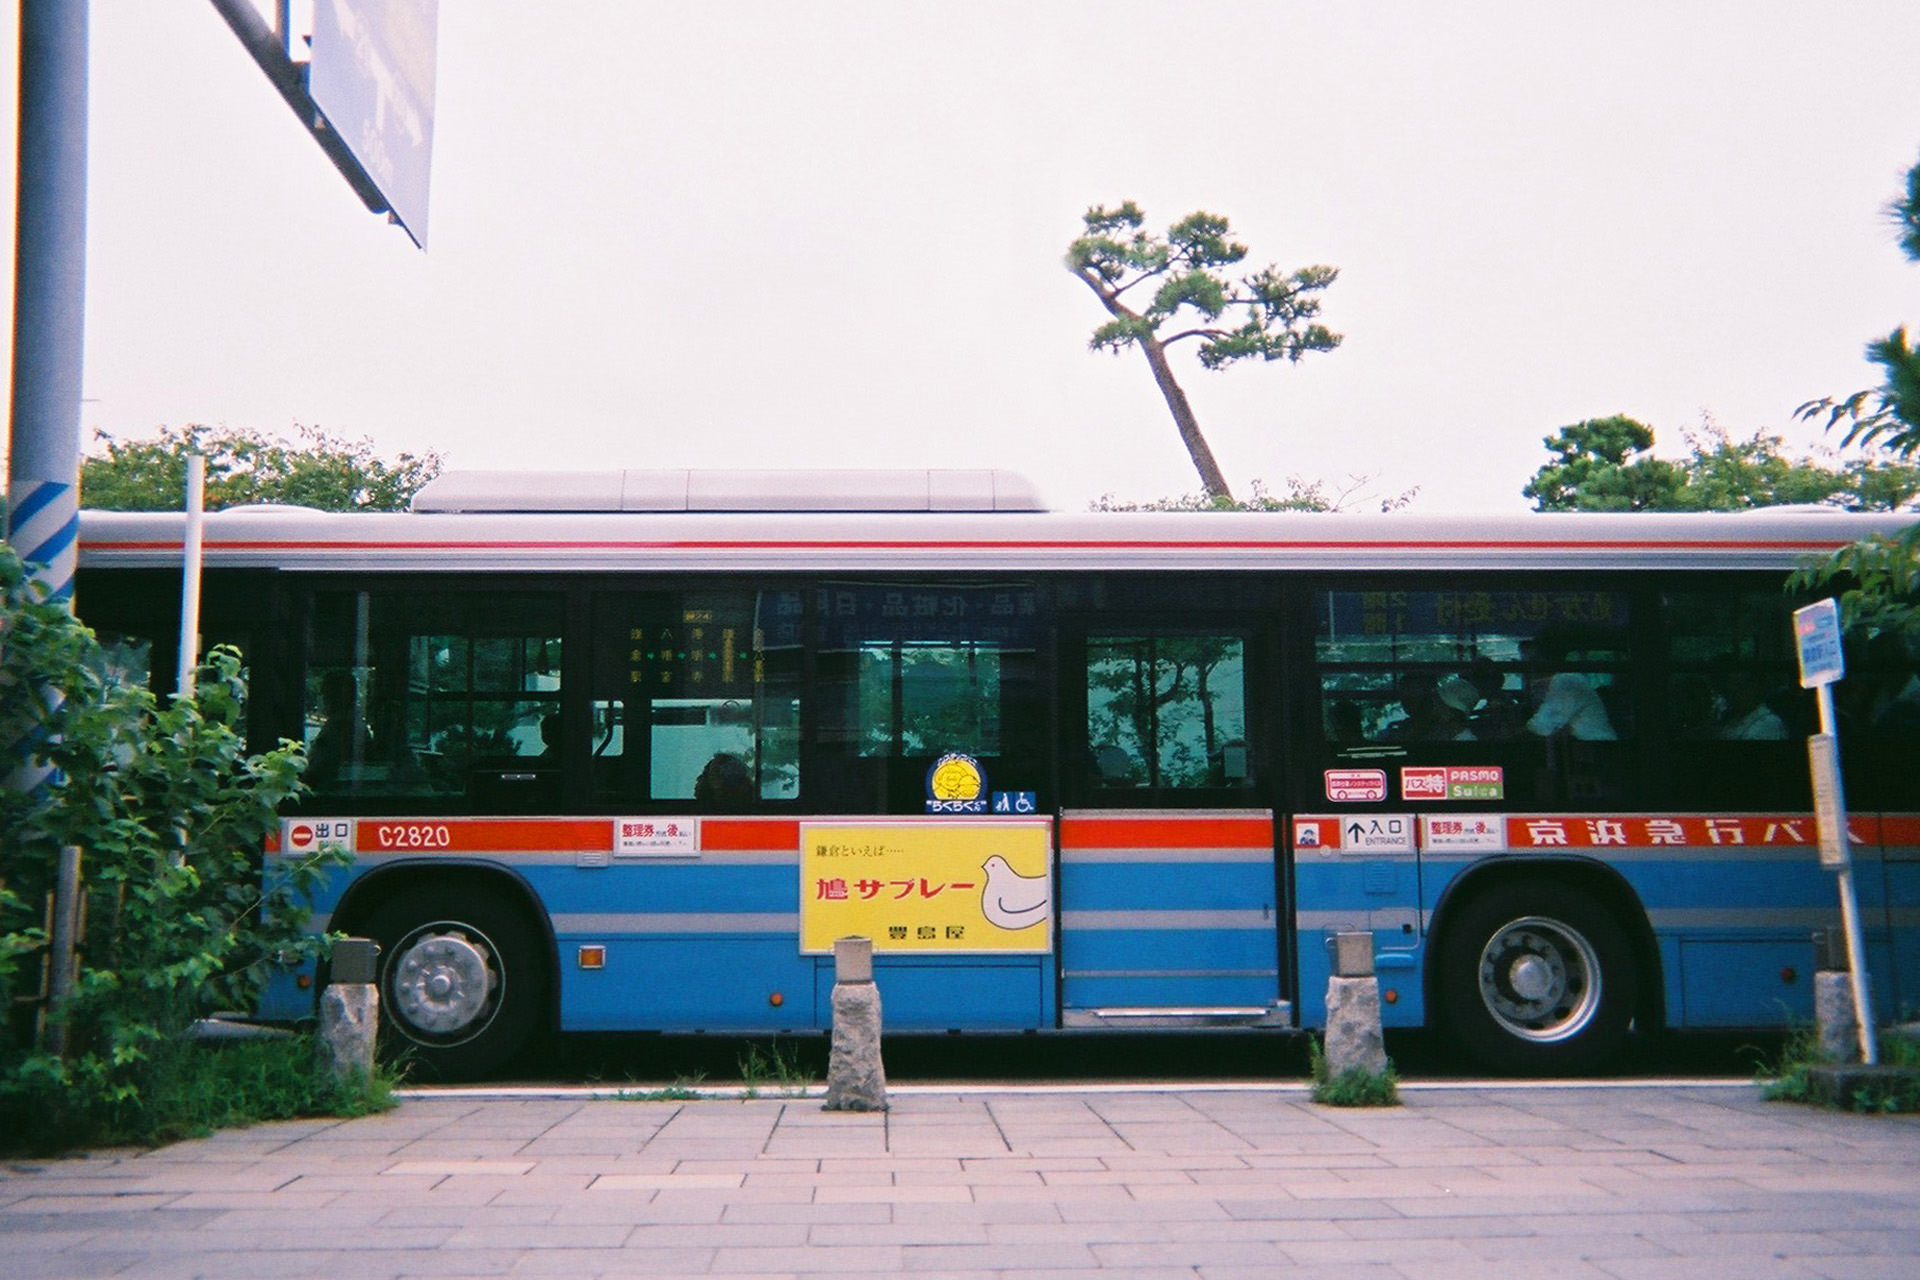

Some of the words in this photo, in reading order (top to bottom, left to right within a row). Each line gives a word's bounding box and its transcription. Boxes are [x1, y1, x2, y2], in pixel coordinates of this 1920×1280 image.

[1405, 773, 1445, 793] バス特
[1449, 770, 1499, 782] PASMO
[1453, 785, 1498, 797] Suica
[315, 823, 348, 838] 出口
[1369, 819, 1402, 834] 入口
[378, 825, 451, 848] C2820
[1365, 837, 1406, 846] ENTRANCE
[815, 877, 976, 901] 鳩サブレー
